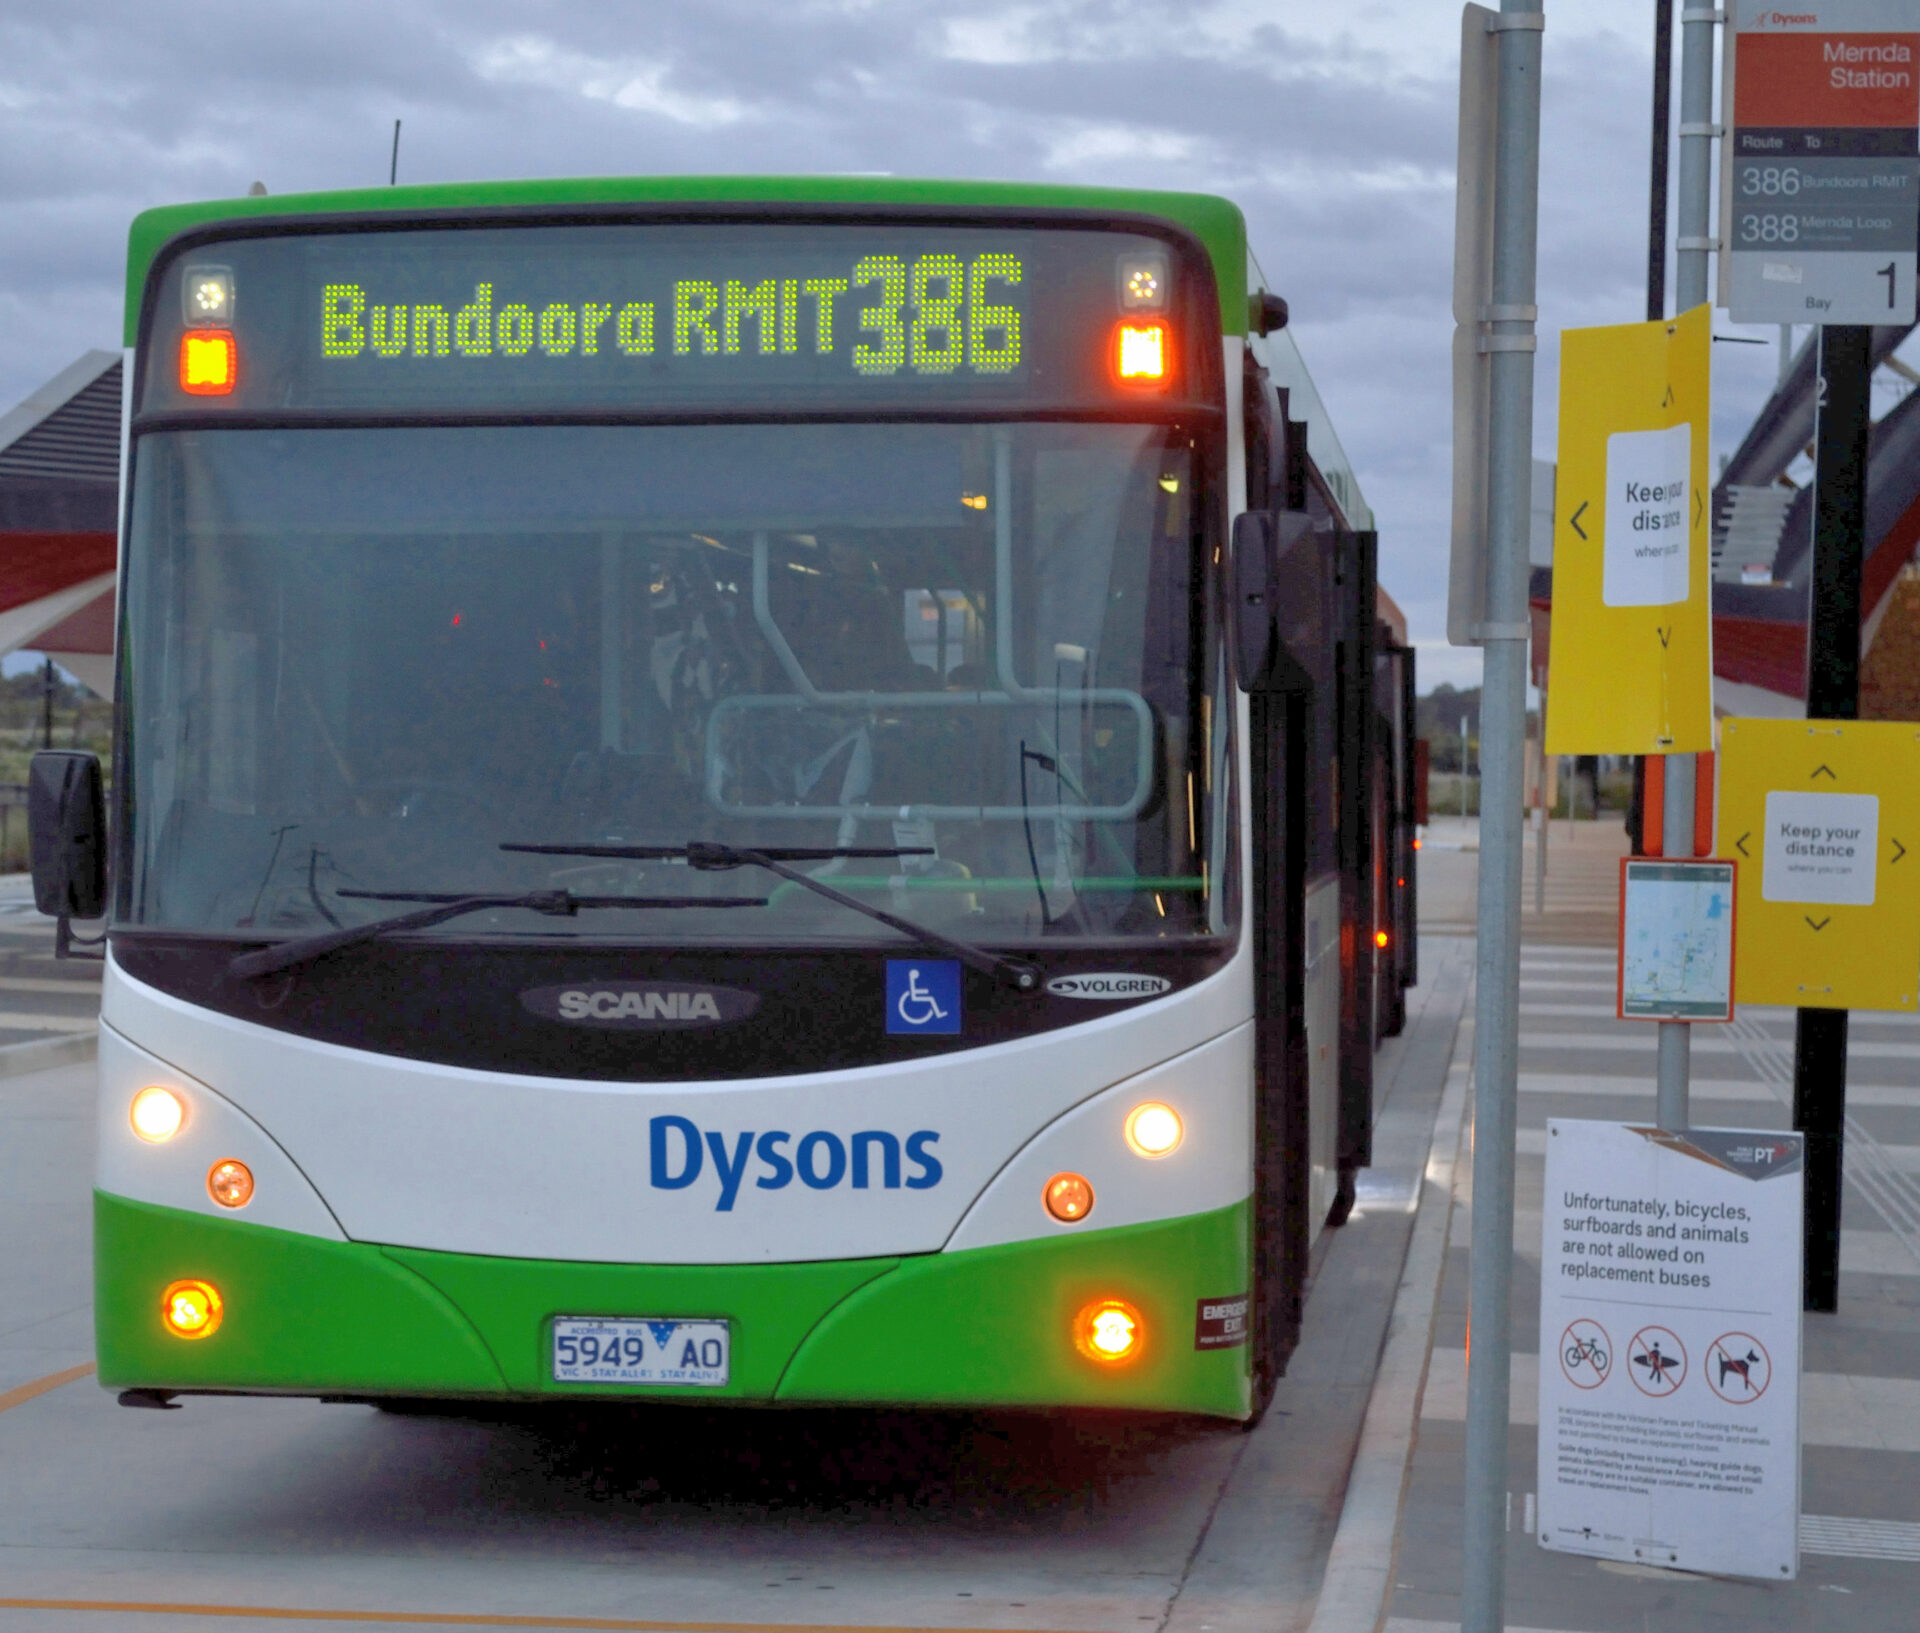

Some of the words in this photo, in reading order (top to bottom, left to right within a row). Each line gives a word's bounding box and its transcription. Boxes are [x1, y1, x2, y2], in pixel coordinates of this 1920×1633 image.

[1772, 12, 1817, 26] Dysons
[1823, 41, 1911, 62] Mernda
[1830, 67, 1910, 88] Station
[1742, 135, 1783, 149] Route
[1805, 136, 1820, 149] To
[1742, 168, 1800, 195] 386
[1802, 175, 1868, 188] Bundoora
[1872, 175, 1908, 188] RMIT
[1741, 214, 1799, 242] 388
[1801, 216, 1853, 228] Mernda
[1857, 216, 1892, 230] Loop
[1806, 297, 1831, 312] Bay
[1877, 262, 1896, 309] 1
[321, 282, 655, 358] Bundoora
[673, 279, 848, 354] RMIT
[852, 253, 1022, 375] 386
[1780, 824, 1822, 842] Keep
[1826, 827, 1861, 842] your
[1785, 841, 1855, 858] distance
[1079, 975, 1164, 994] VOLGREN
[557, 990, 721, 1021] SCANIA
[649, 1115, 943, 1212] Dysons
[1564, 1191, 1670, 1220] Unfortunately,
[1674, 1200, 1752, 1222] bicycles,
[1563, 1216, 1643, 1237] surfboards
[1646, 1222, 1677, 1239] and
[1681, 1225, 1750, 1244] animals
[1562, 1240, 1586, 1255] are
[1589, 1242, 1614, 1257] not
[1617, 1242, 1679, 1262] allowed
[1683, 1249, 1705, 1264] on
[1561, 1261, 1655, 1284] replacement
[1659, 1268, 1711, 1288] buses
[558, 1336, 644, 1367] 5949
[561, 1368, 579, 1377] VIC
[592, 1369, 618, 1378] STAY
[660, 1370, 686, 1379] STAY
